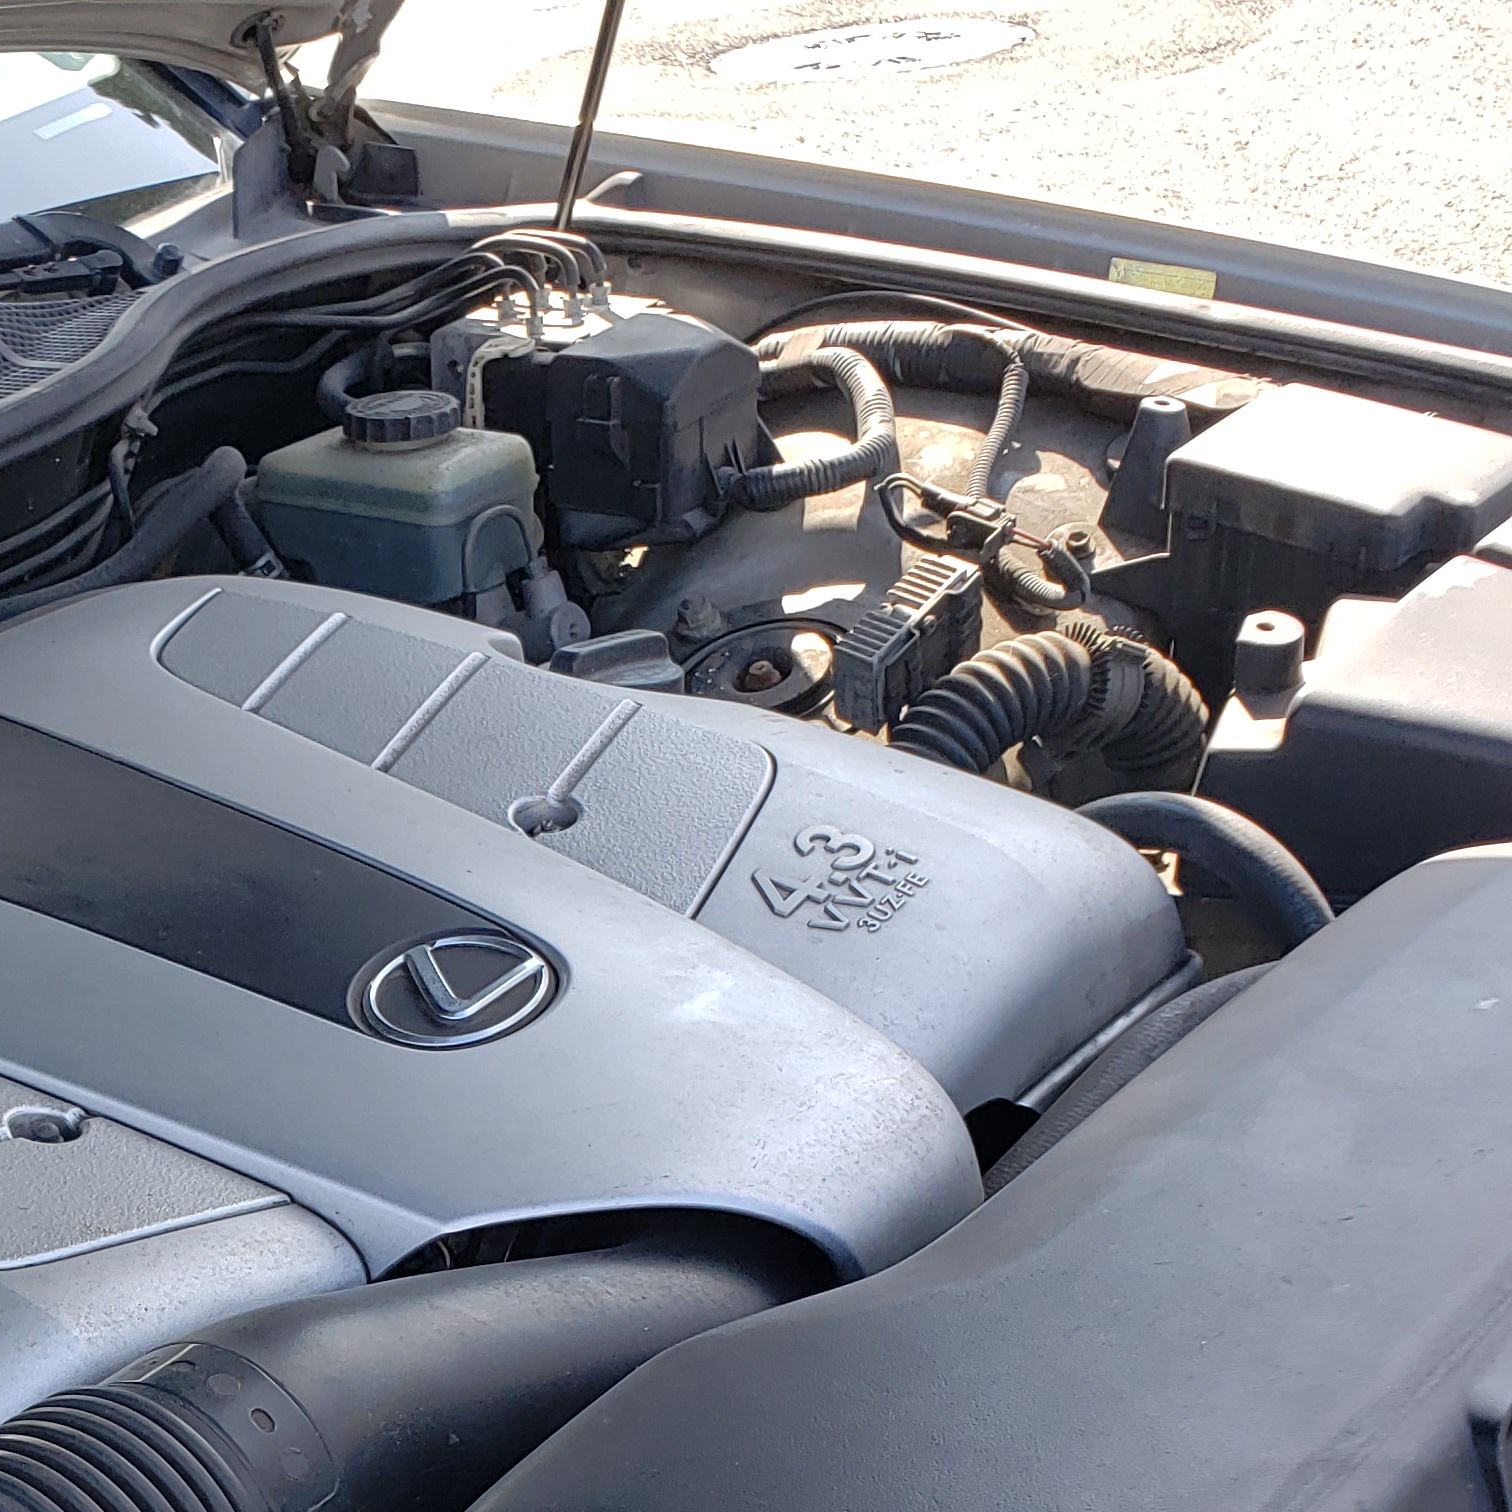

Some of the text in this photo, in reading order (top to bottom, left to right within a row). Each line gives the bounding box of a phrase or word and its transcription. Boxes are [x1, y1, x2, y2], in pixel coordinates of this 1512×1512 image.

[751, 825, 876, 918] 4.3
[807, 848, 918, 931] VVT-i
[857, 872, 929, 933] 3UZ-FE
